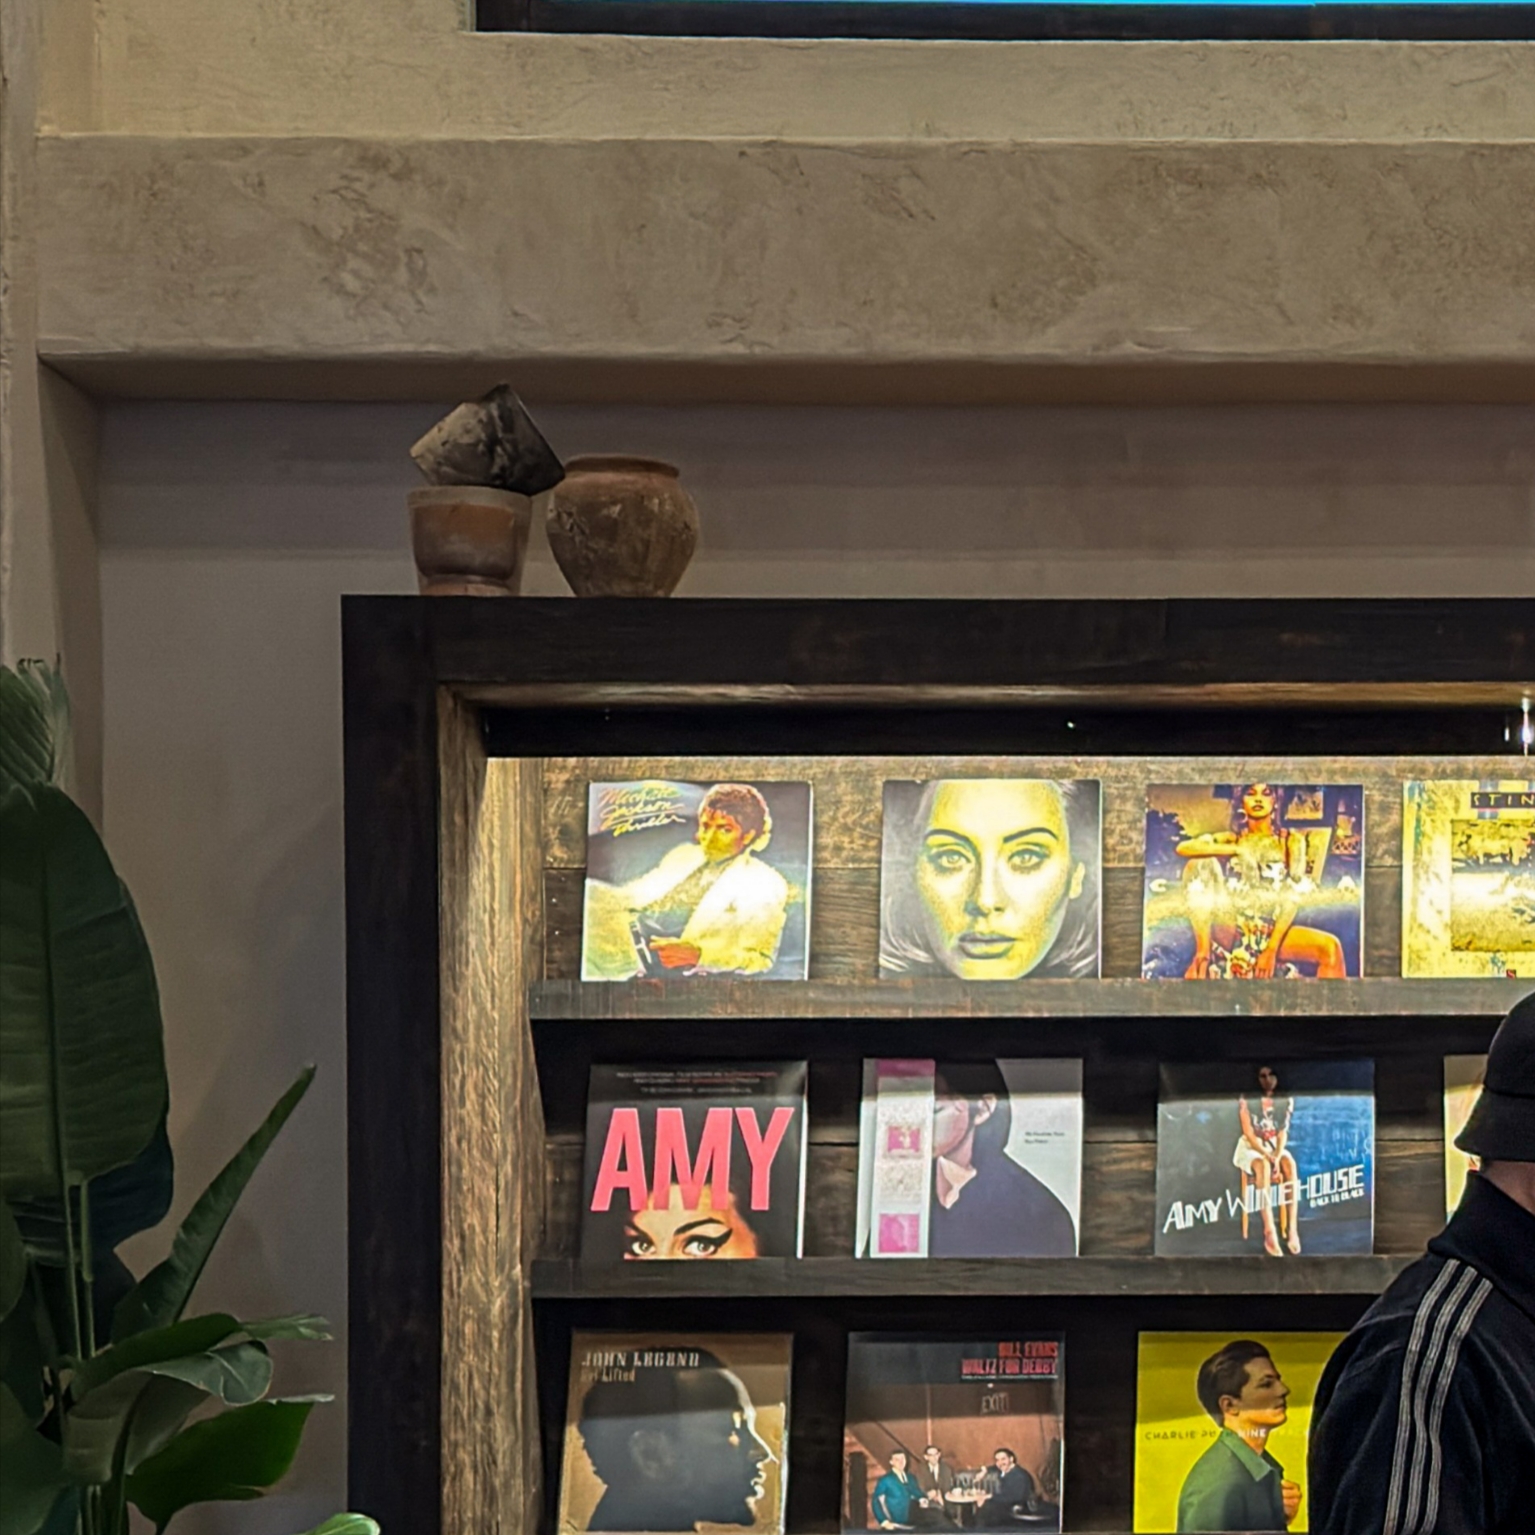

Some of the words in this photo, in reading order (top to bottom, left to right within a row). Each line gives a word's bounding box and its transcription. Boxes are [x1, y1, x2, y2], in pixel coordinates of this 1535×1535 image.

[590, 1107, 795, 1212] AMY
[1163, 1197, 1222, 1234] AMY
[1225, 1164, 1365, 1218] WINEHOUSE
[582, 1352, 626, 1367] JOHN
[633, 1352, 699, 1367] LEGEND
[1145, 1430, 1196, 1440] CHARLIE
